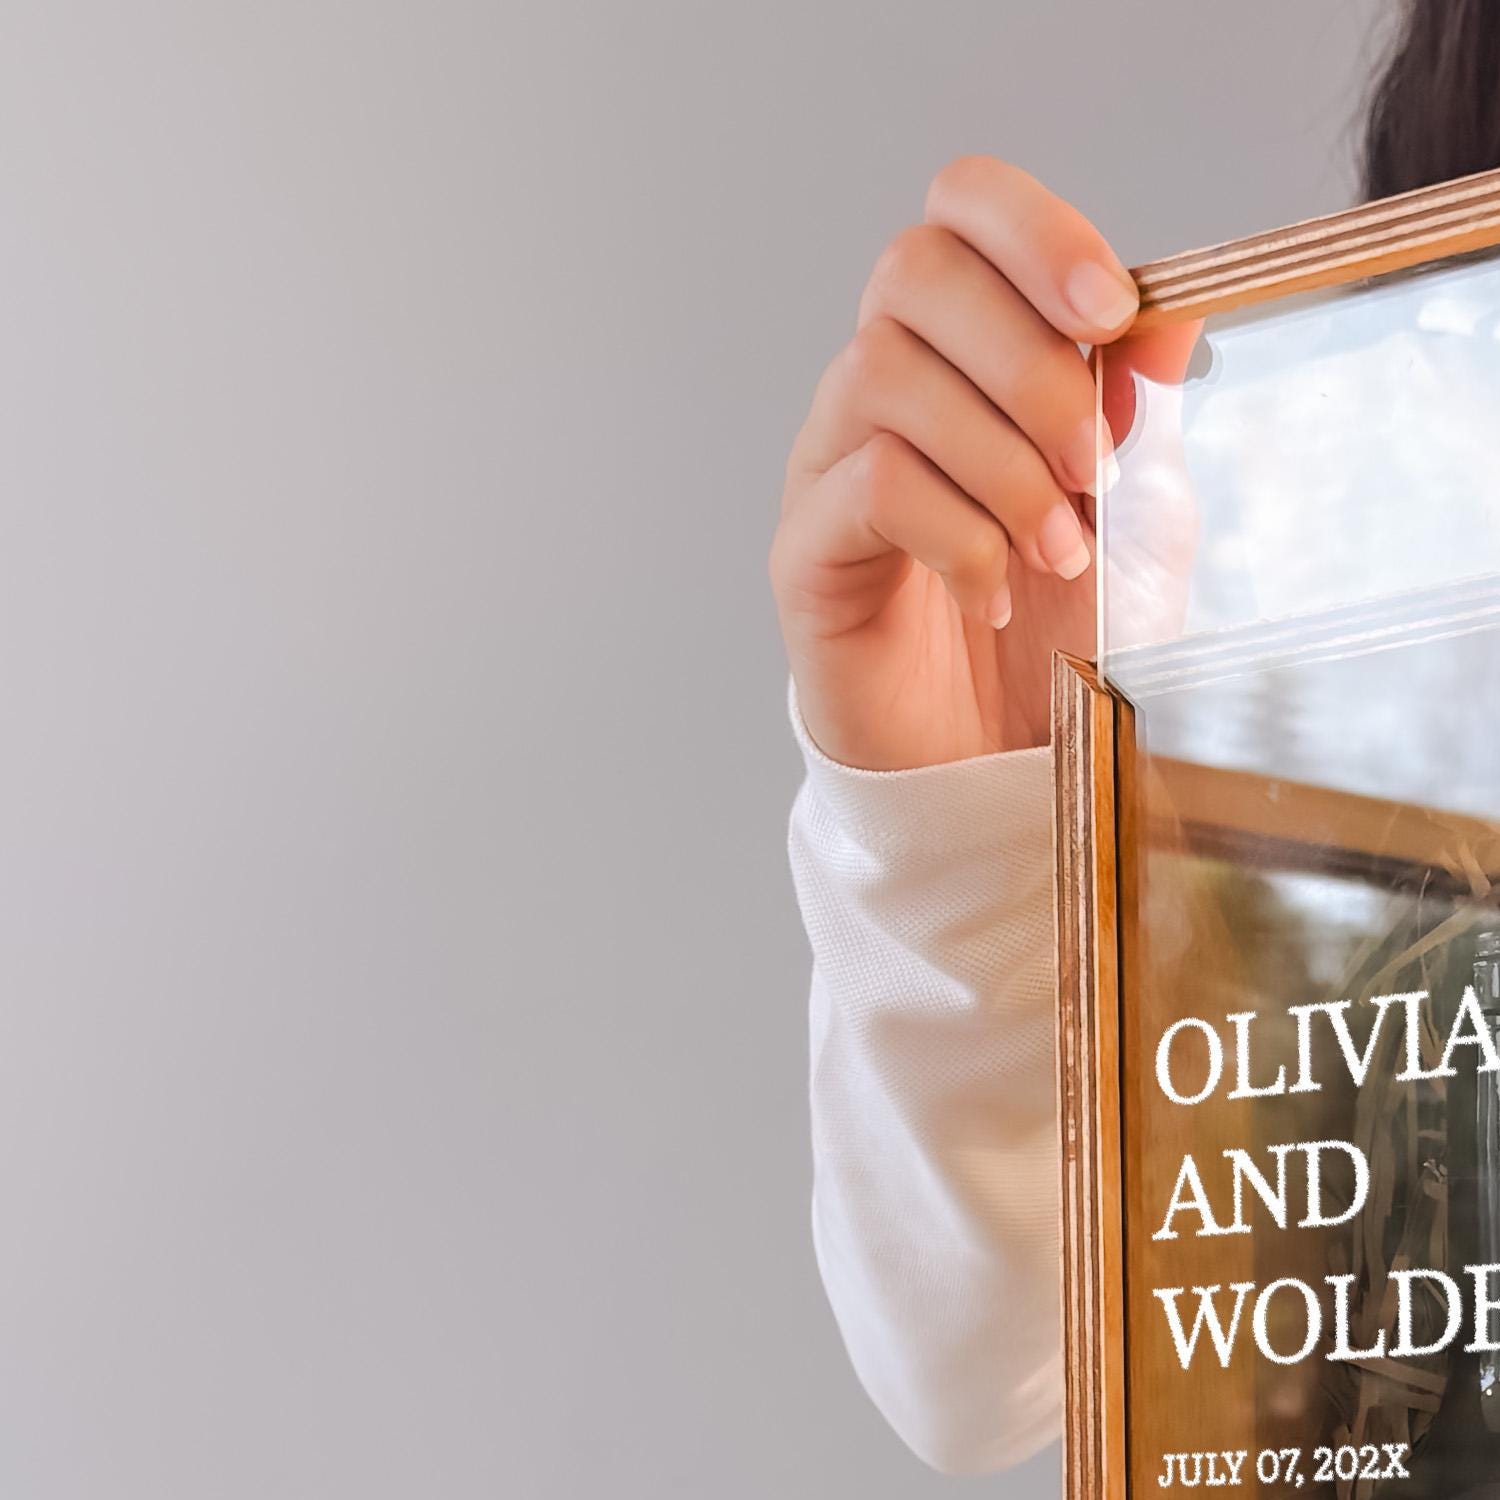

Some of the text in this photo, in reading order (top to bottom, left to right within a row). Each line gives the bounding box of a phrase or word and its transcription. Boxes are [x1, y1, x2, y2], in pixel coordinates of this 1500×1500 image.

[1152, 1139, 1370, 1241] AND
[1157, 1442, 1410, 1488] JULY 07, 202X
